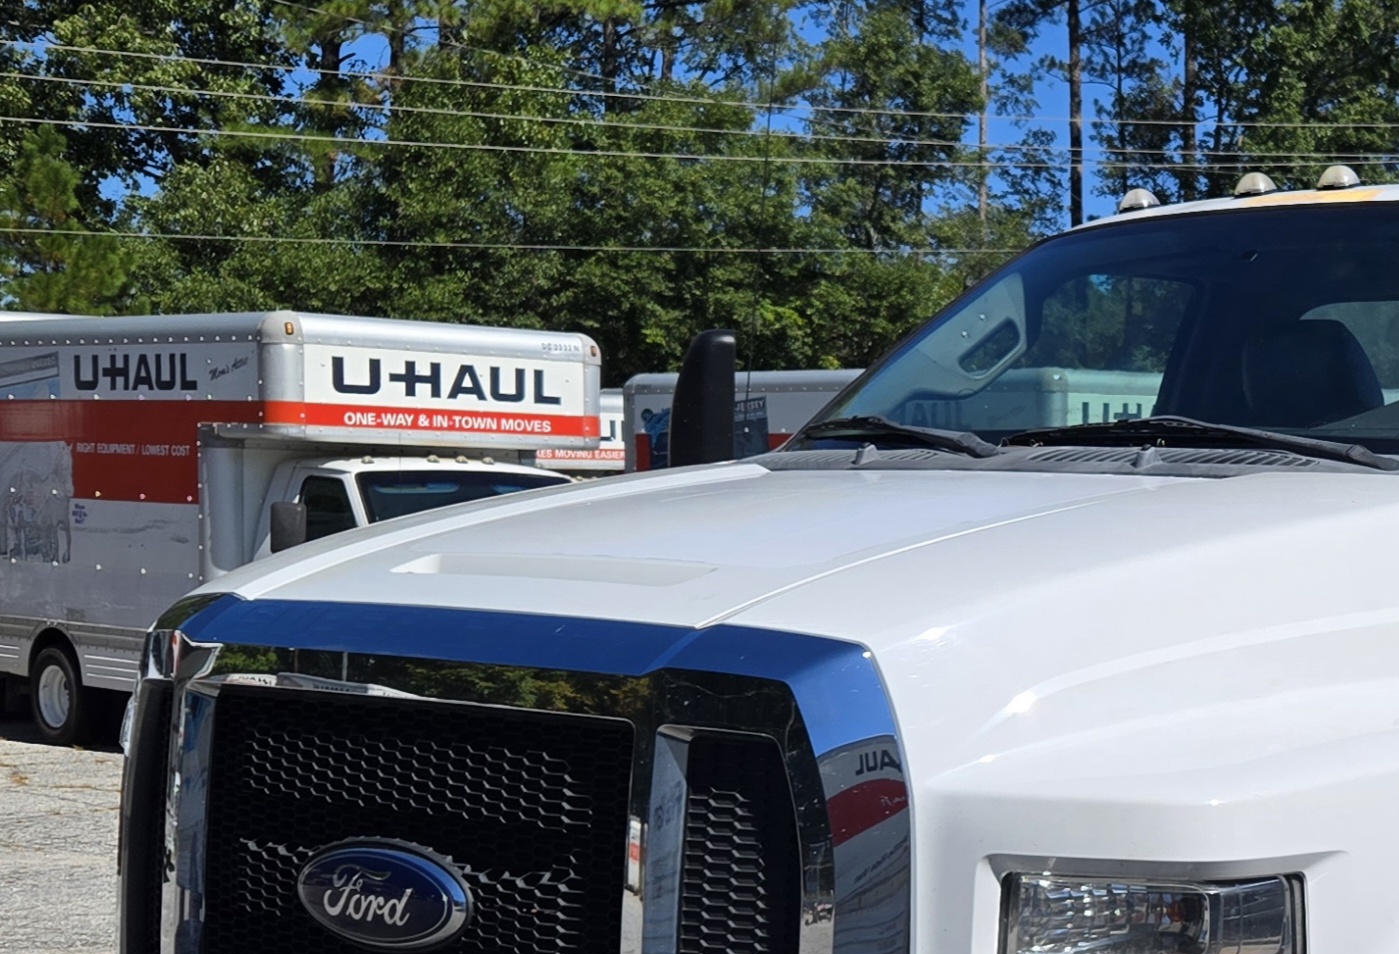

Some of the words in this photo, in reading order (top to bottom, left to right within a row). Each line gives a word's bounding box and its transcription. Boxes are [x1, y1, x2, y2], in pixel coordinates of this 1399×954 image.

[74, 353, 197, 391] U-HAUL
[332, 356, 561, 405] U-HAUL
[344, 411, 414, 428] ONE-WAY
[418, 414, 430, 427] &
[433, 415, 498, 430] IN-TOWN
[501, 418, 551, 433] MOVES
[76, 443, 96, 453] RIGHT
[97, 443, 135, 455] EQUIPMENT
[142, 445, 169, 456] LOWEST
[171, 445, 190, 456] COST
[536, 450, 552, 459] KES
[555, 450, 593, 459] MOVING
[323, 864, 413, 926] Ford
